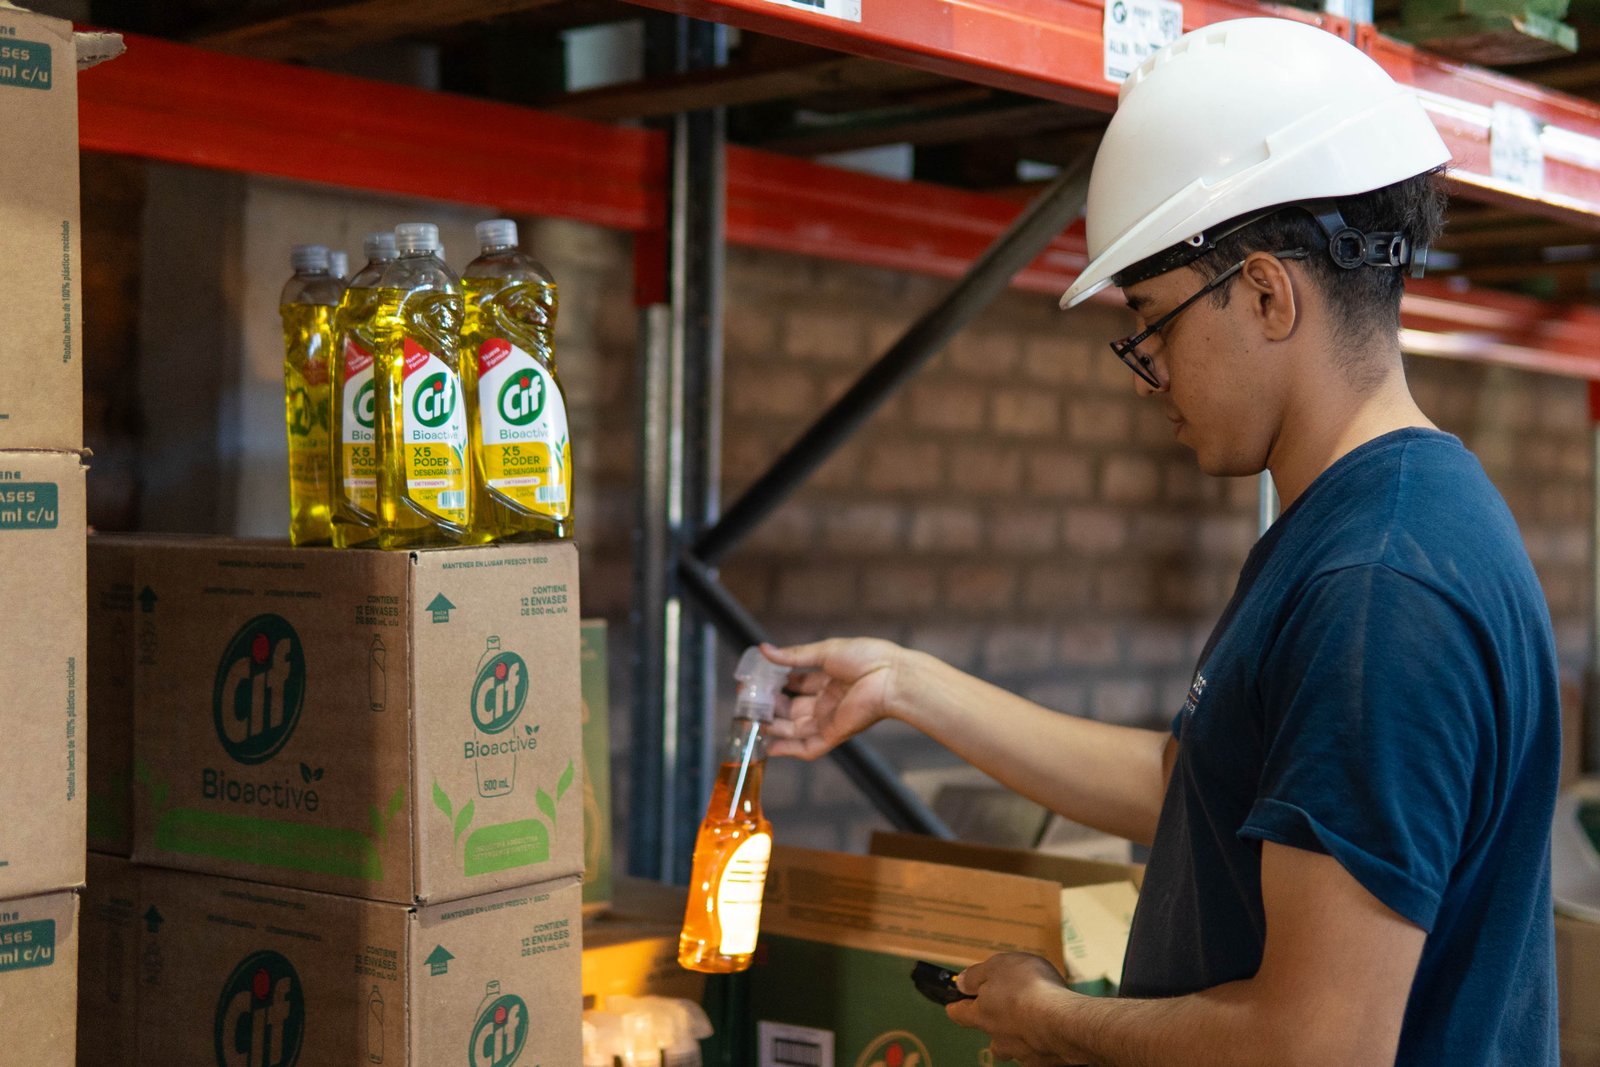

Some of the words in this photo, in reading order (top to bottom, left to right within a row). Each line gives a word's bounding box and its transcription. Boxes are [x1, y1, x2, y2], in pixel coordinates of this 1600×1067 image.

[21, 66, 49, 83] c/u
[62, 282, 71, 301] 100%
[62, 303, 71, 312] de
[417, 374, 452, 421] Cif
[503, 375, 542, 420] Cif
[414, 458, 449, 466] PODER
[503, 456, 540, 466] PODER
[1, 508, 22, 522] ml
[26, 507, 55, 524] c/u
[532, 584, 567, 594] CONTIENE
[520, 597, 529, 606] 12
[531, 595, 567, 606] ENVASES
[365, 606, 399, 617] ENVASES
[521, 608, 530, 616] DE
[222, 633, 291, 743] Cif
[476, 662, 520, 724] Cif
[464, 736, 537, 759] Bioactive
[202, 767, 319, 812] Bioactive
[484, 779, 496, 790] 500
[532, 930, 569, 945] ENVASES
[23, 945, 51, 962] c/u
[223, 968, 291, 1067] Cif
[474, 1003, 520, 1067] Cif
